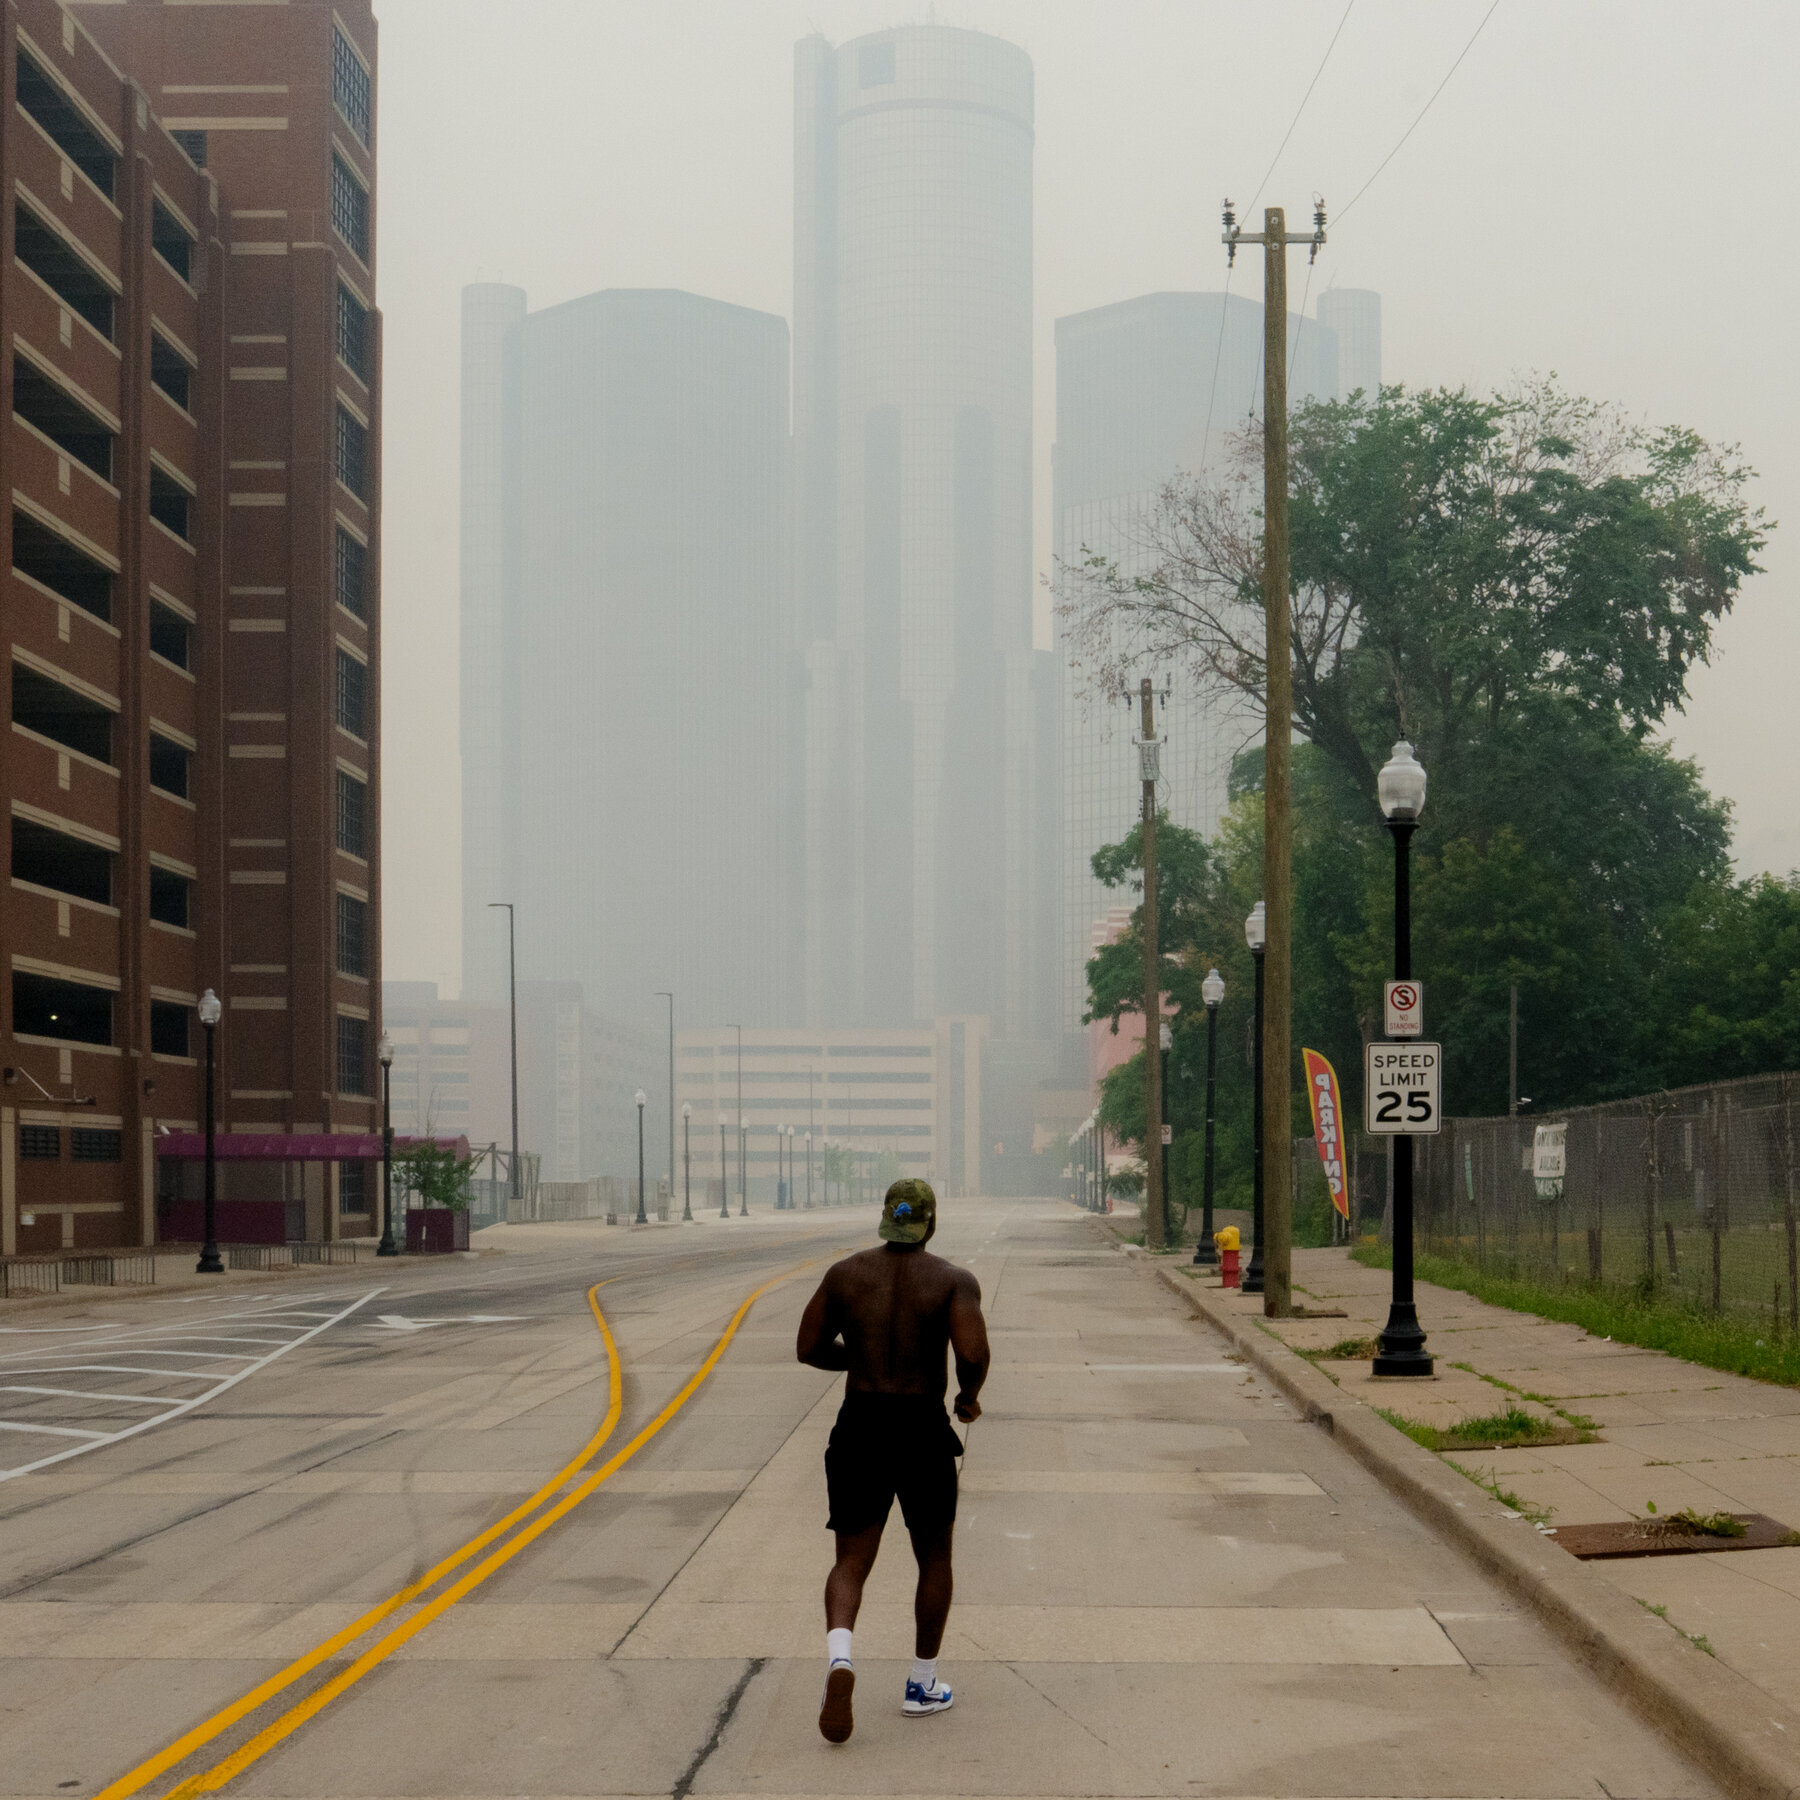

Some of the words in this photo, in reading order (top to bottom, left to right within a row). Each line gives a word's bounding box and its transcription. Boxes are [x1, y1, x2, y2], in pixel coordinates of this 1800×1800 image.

[1389, 1022, 1419, 1030] STANDING
[1374, 1055, 1435, 1068] SPEED
[1380, 1073, 1427, 1086] LIMIT
[1376, 1091, 1432, 1123] 25
